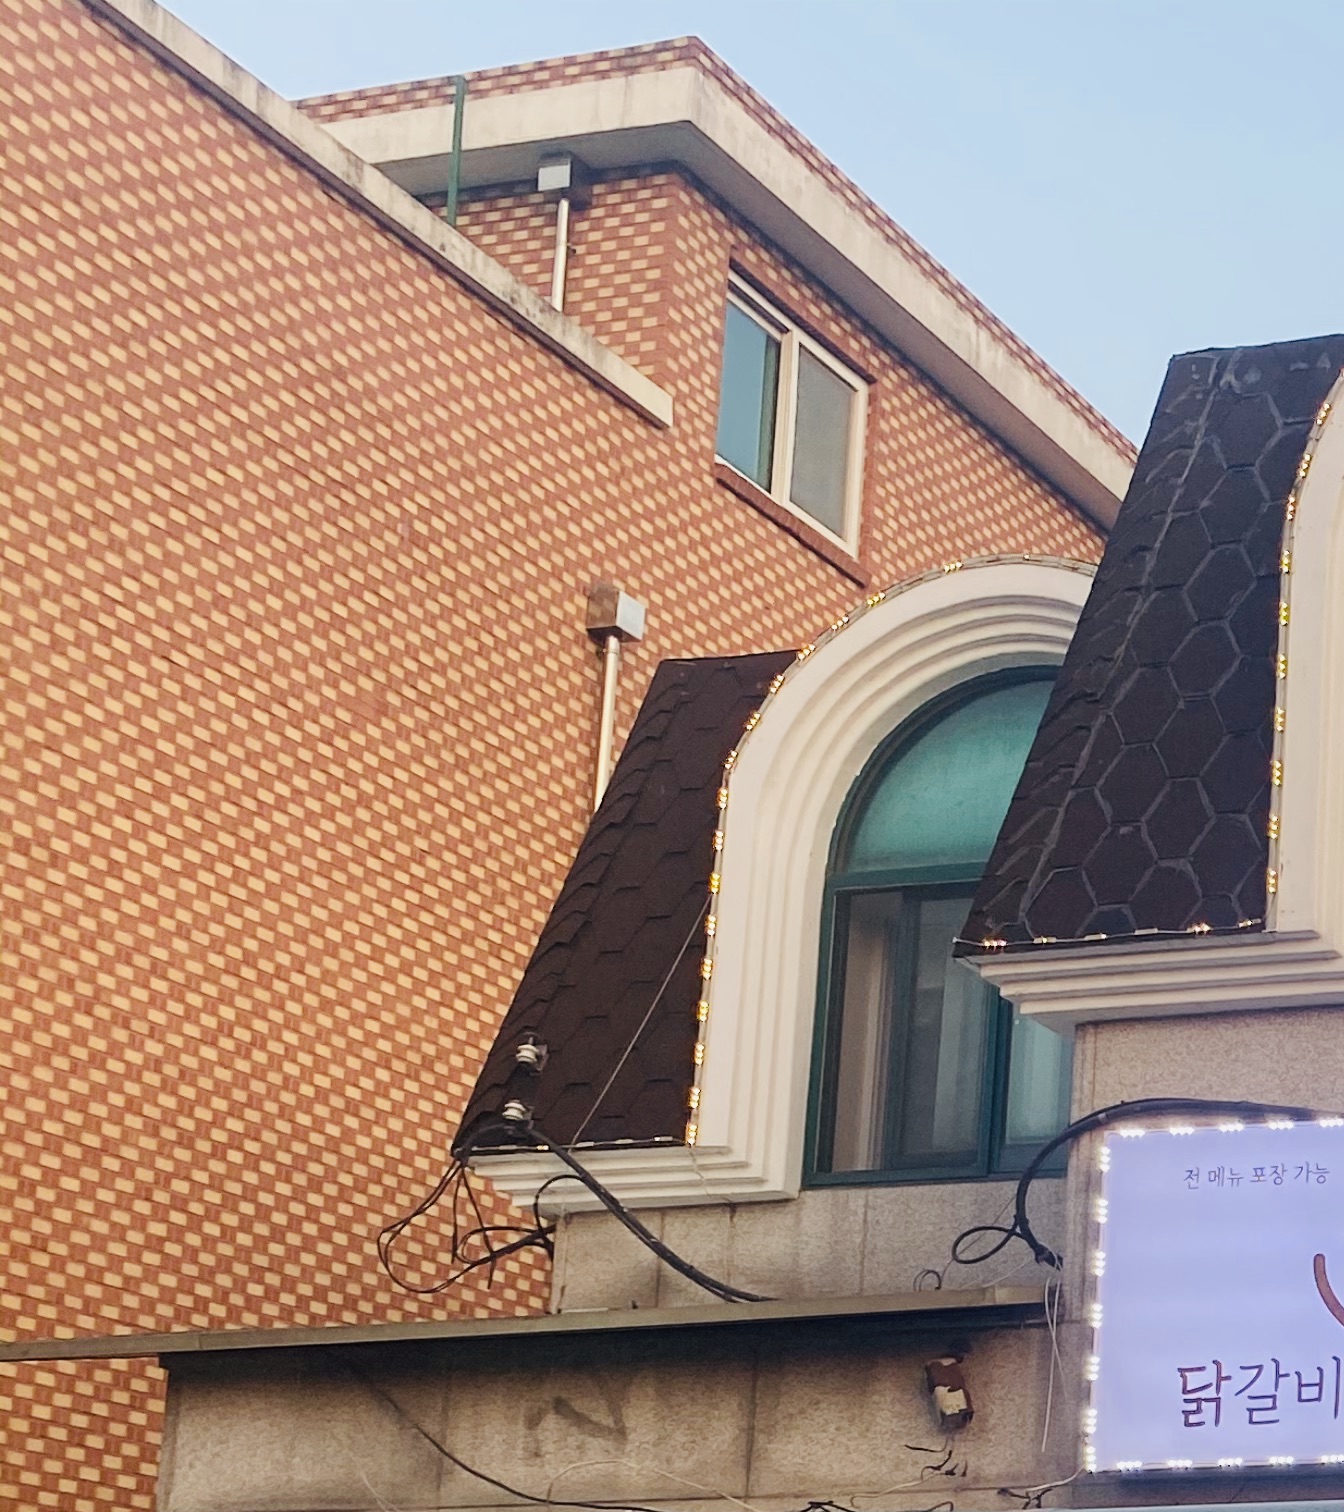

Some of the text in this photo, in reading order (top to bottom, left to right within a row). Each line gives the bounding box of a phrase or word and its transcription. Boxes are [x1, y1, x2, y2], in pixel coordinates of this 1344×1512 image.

[1184, 1160, 1331, 1190] 전 메뉴 포장 가능
[1177, 1355, 1341, 1427] 닭갈비
